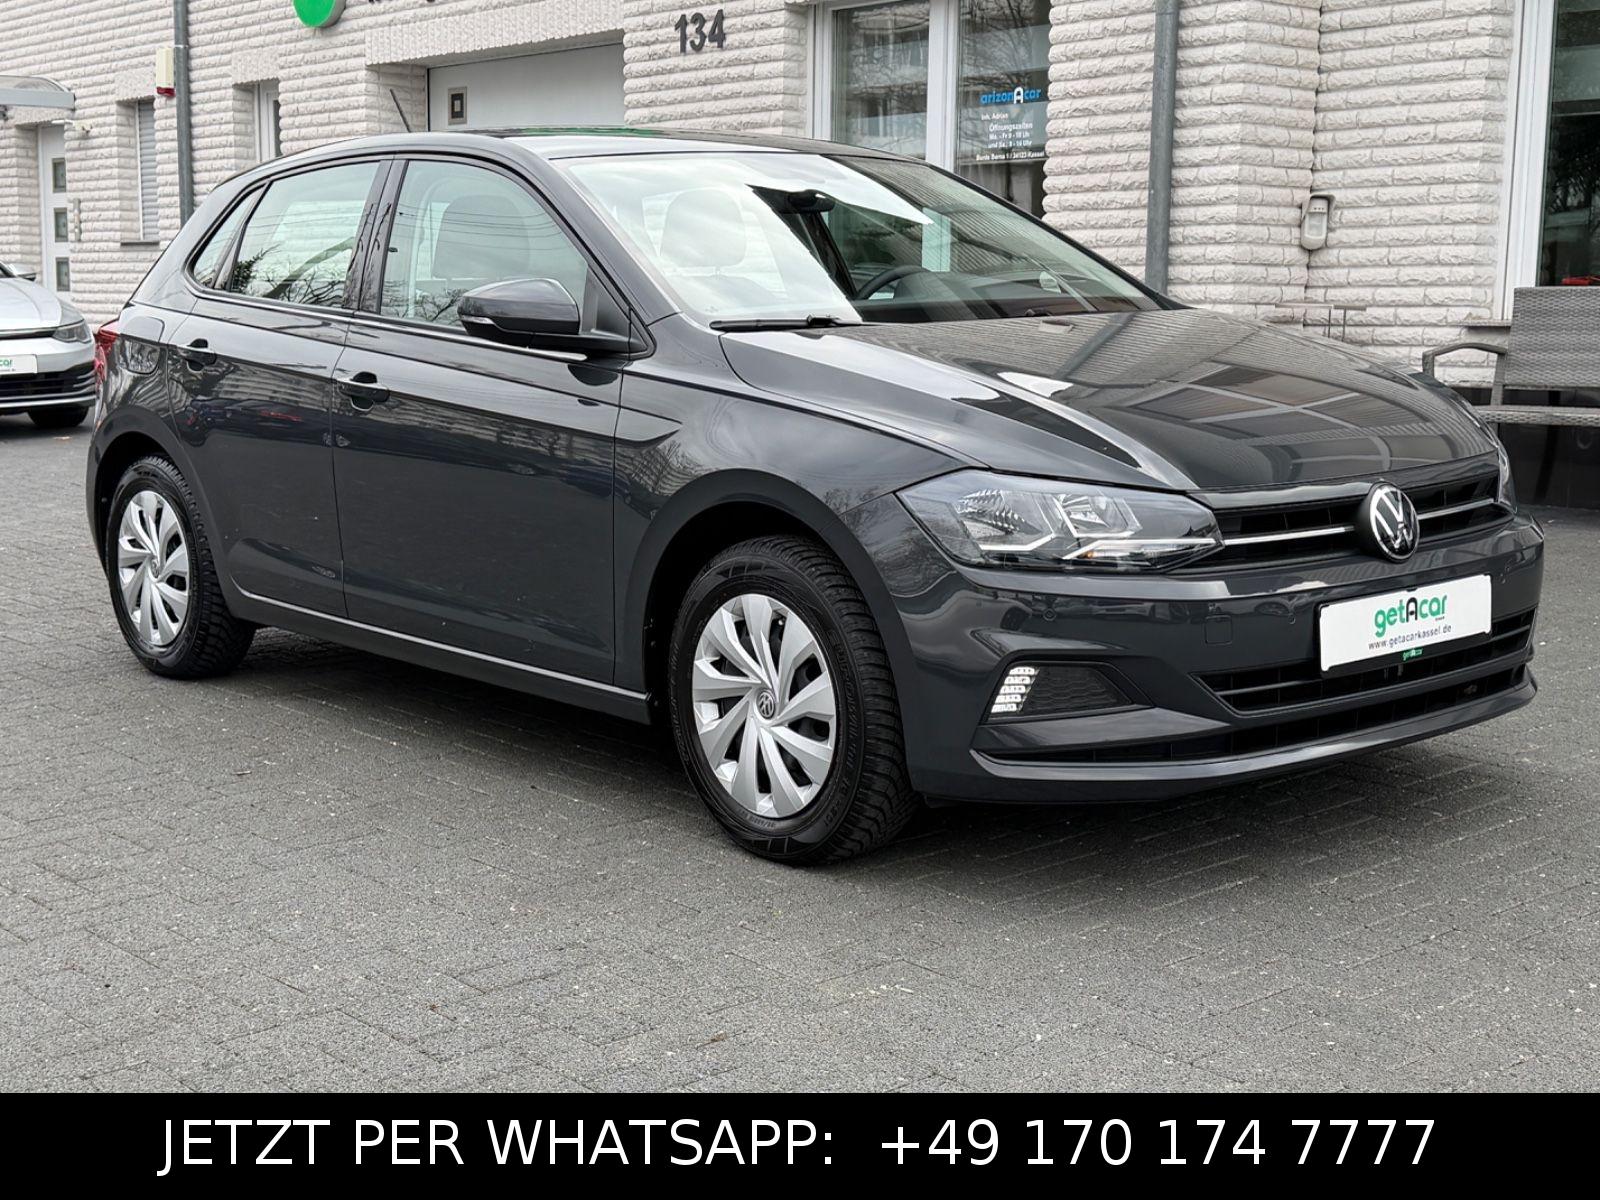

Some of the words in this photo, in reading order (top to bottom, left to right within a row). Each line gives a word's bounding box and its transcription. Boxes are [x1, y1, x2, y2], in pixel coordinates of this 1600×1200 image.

[674, 9, 726, 54] 134
[980, 87, 1041, 104] arizonAcar
[989, 122, 1033, 131] Öffnungszeiten
[1374, 595, 1448, 638] getAcar
[1368, 624, 1452, 651] www.getacarkassel.de
